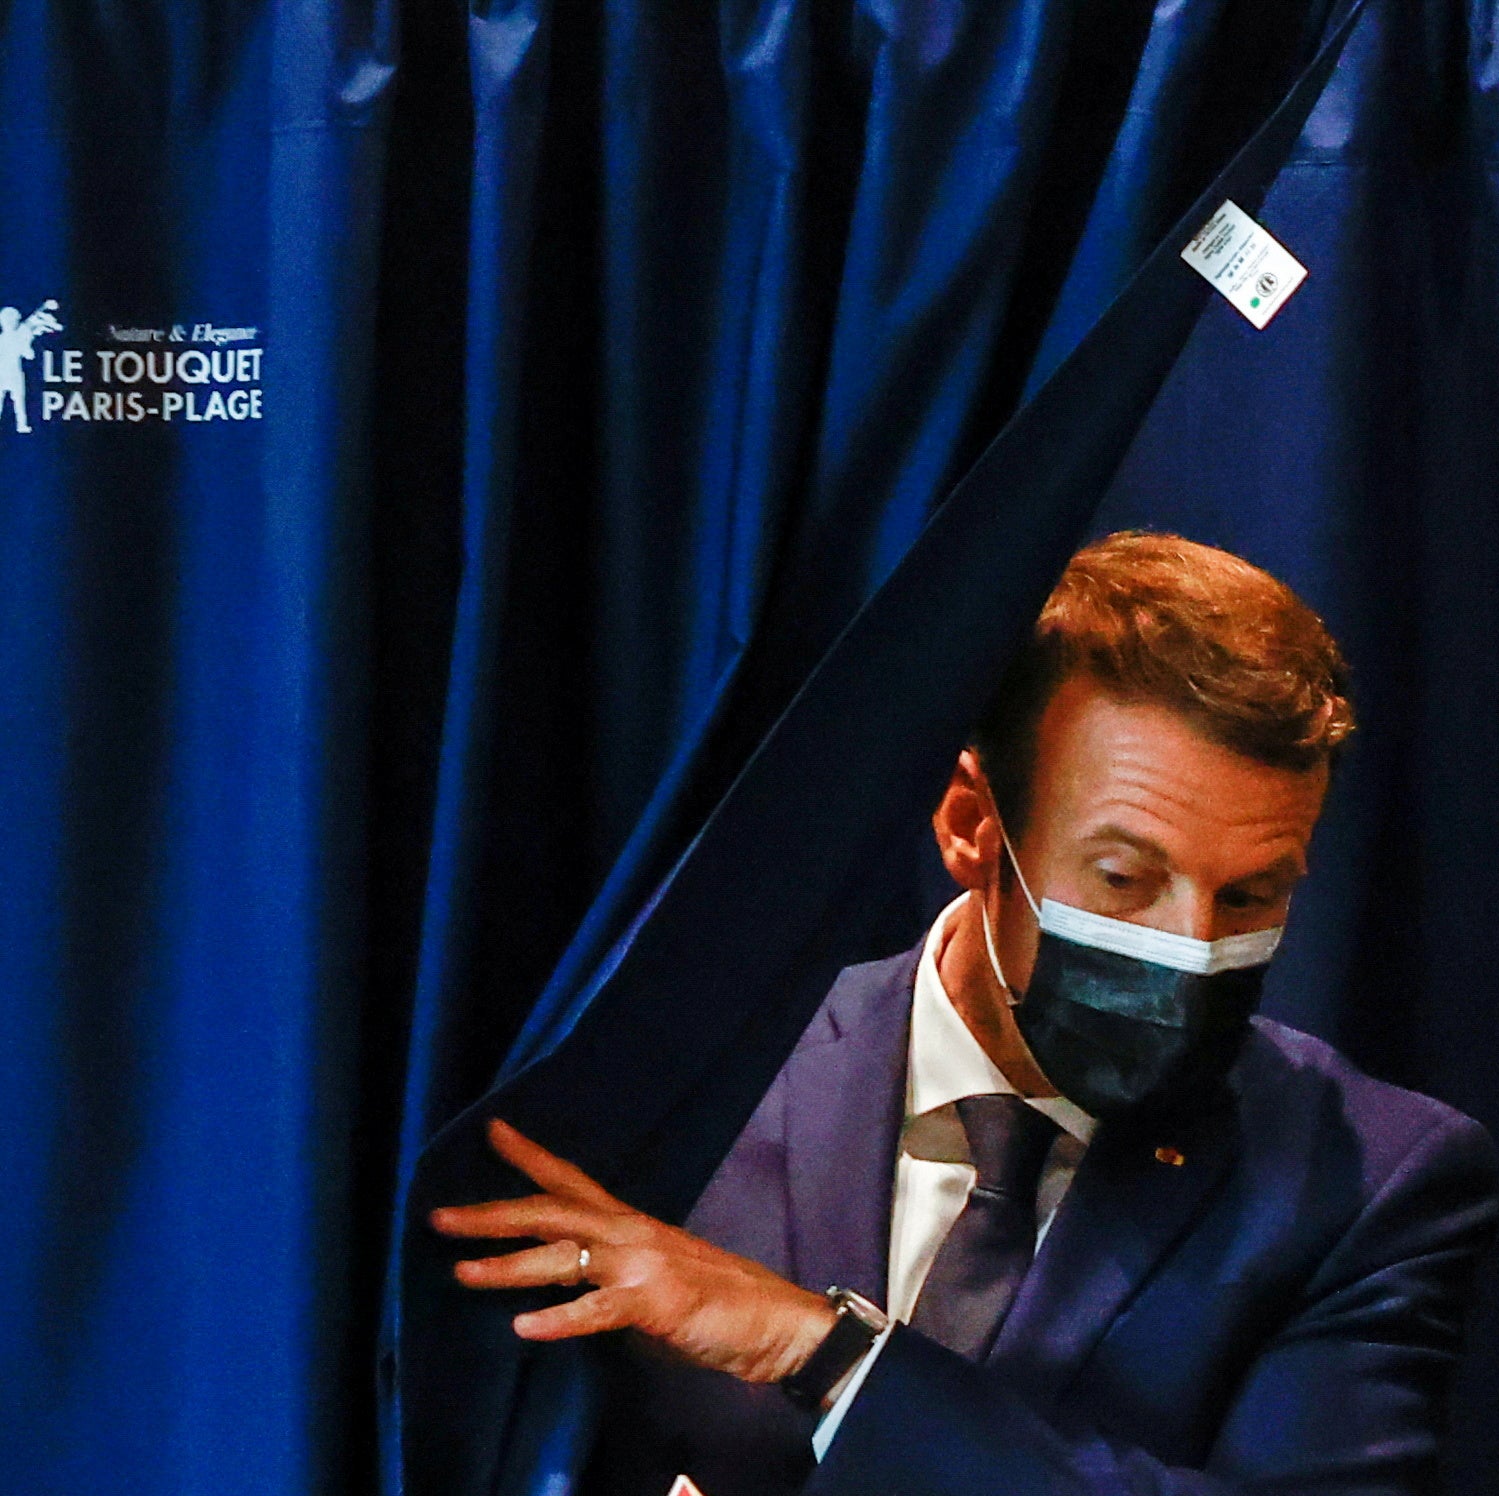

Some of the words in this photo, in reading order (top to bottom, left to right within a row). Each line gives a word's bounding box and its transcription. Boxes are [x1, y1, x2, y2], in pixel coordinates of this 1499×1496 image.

[42, 350, 83, 383] LE
[96, 348, 263, 384] TOUQUET
[42, 389, 263, 422] PARIS-PLAGE
